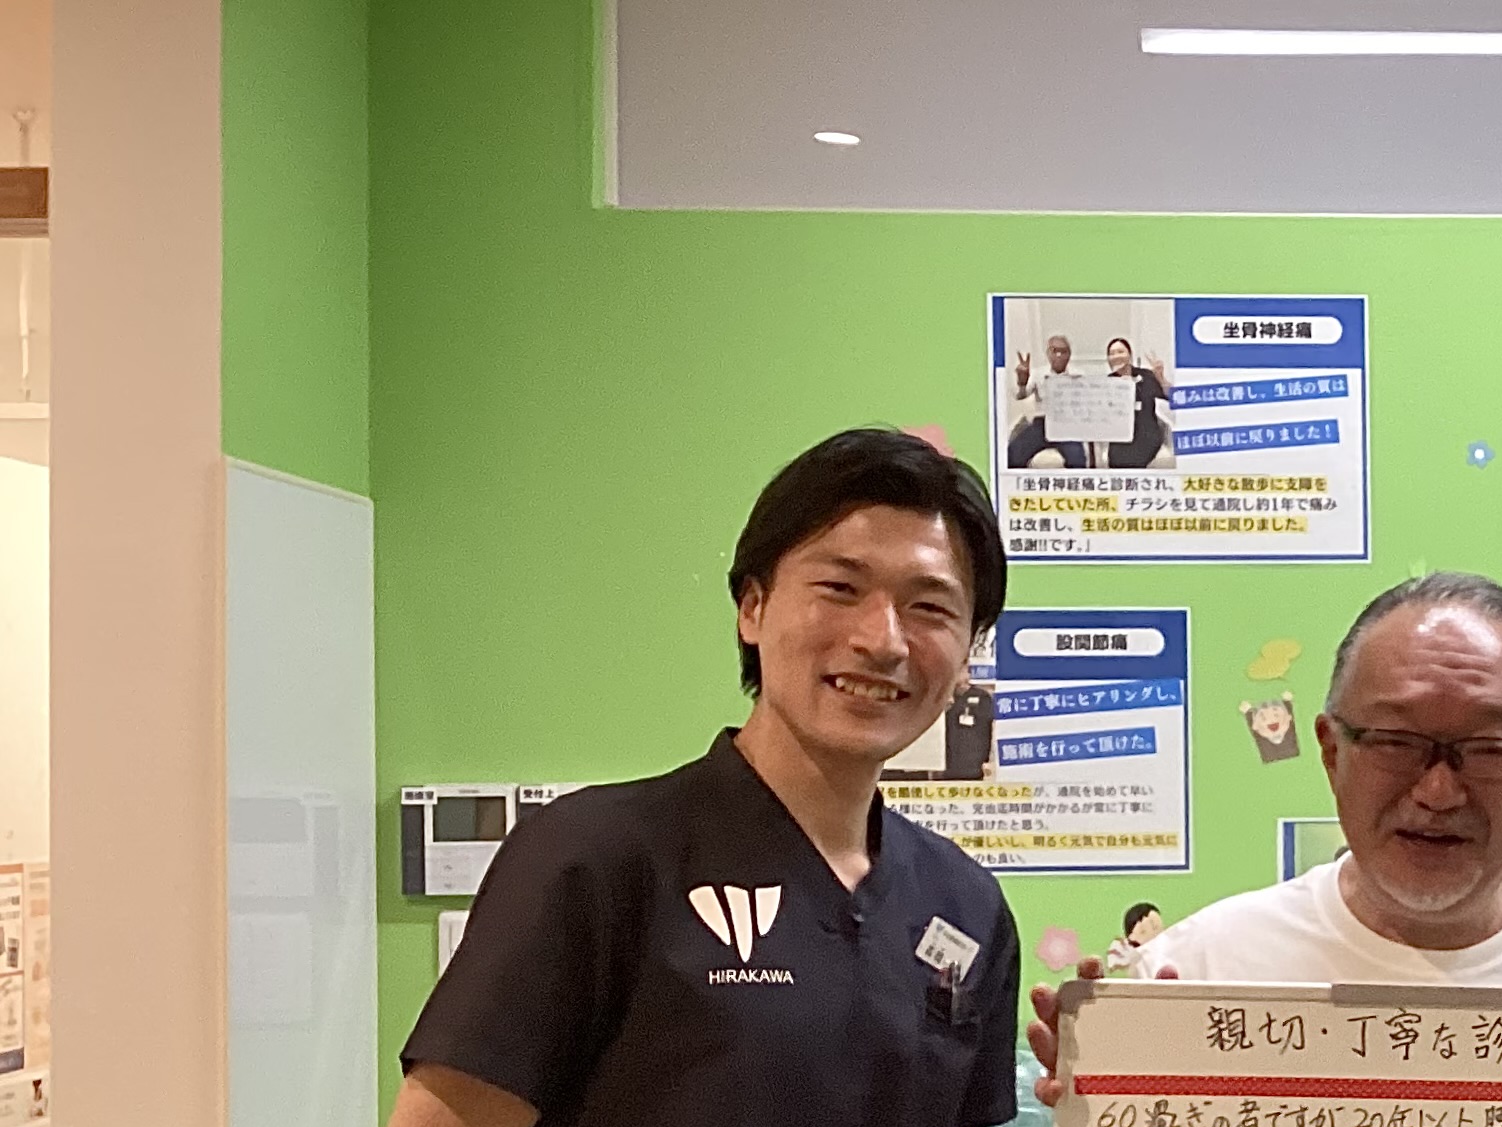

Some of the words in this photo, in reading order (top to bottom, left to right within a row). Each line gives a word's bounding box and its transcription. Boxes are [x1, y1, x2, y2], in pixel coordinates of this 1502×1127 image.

[1223, 321, 1312, 340] 坐骨神経痛
[1172, 376, 1345, 406] 痛みは改善し、生活の質は
[1056, 634, 1128, 651] 股関節痛
[708, 968, 795, 986] HIRAKAWA
